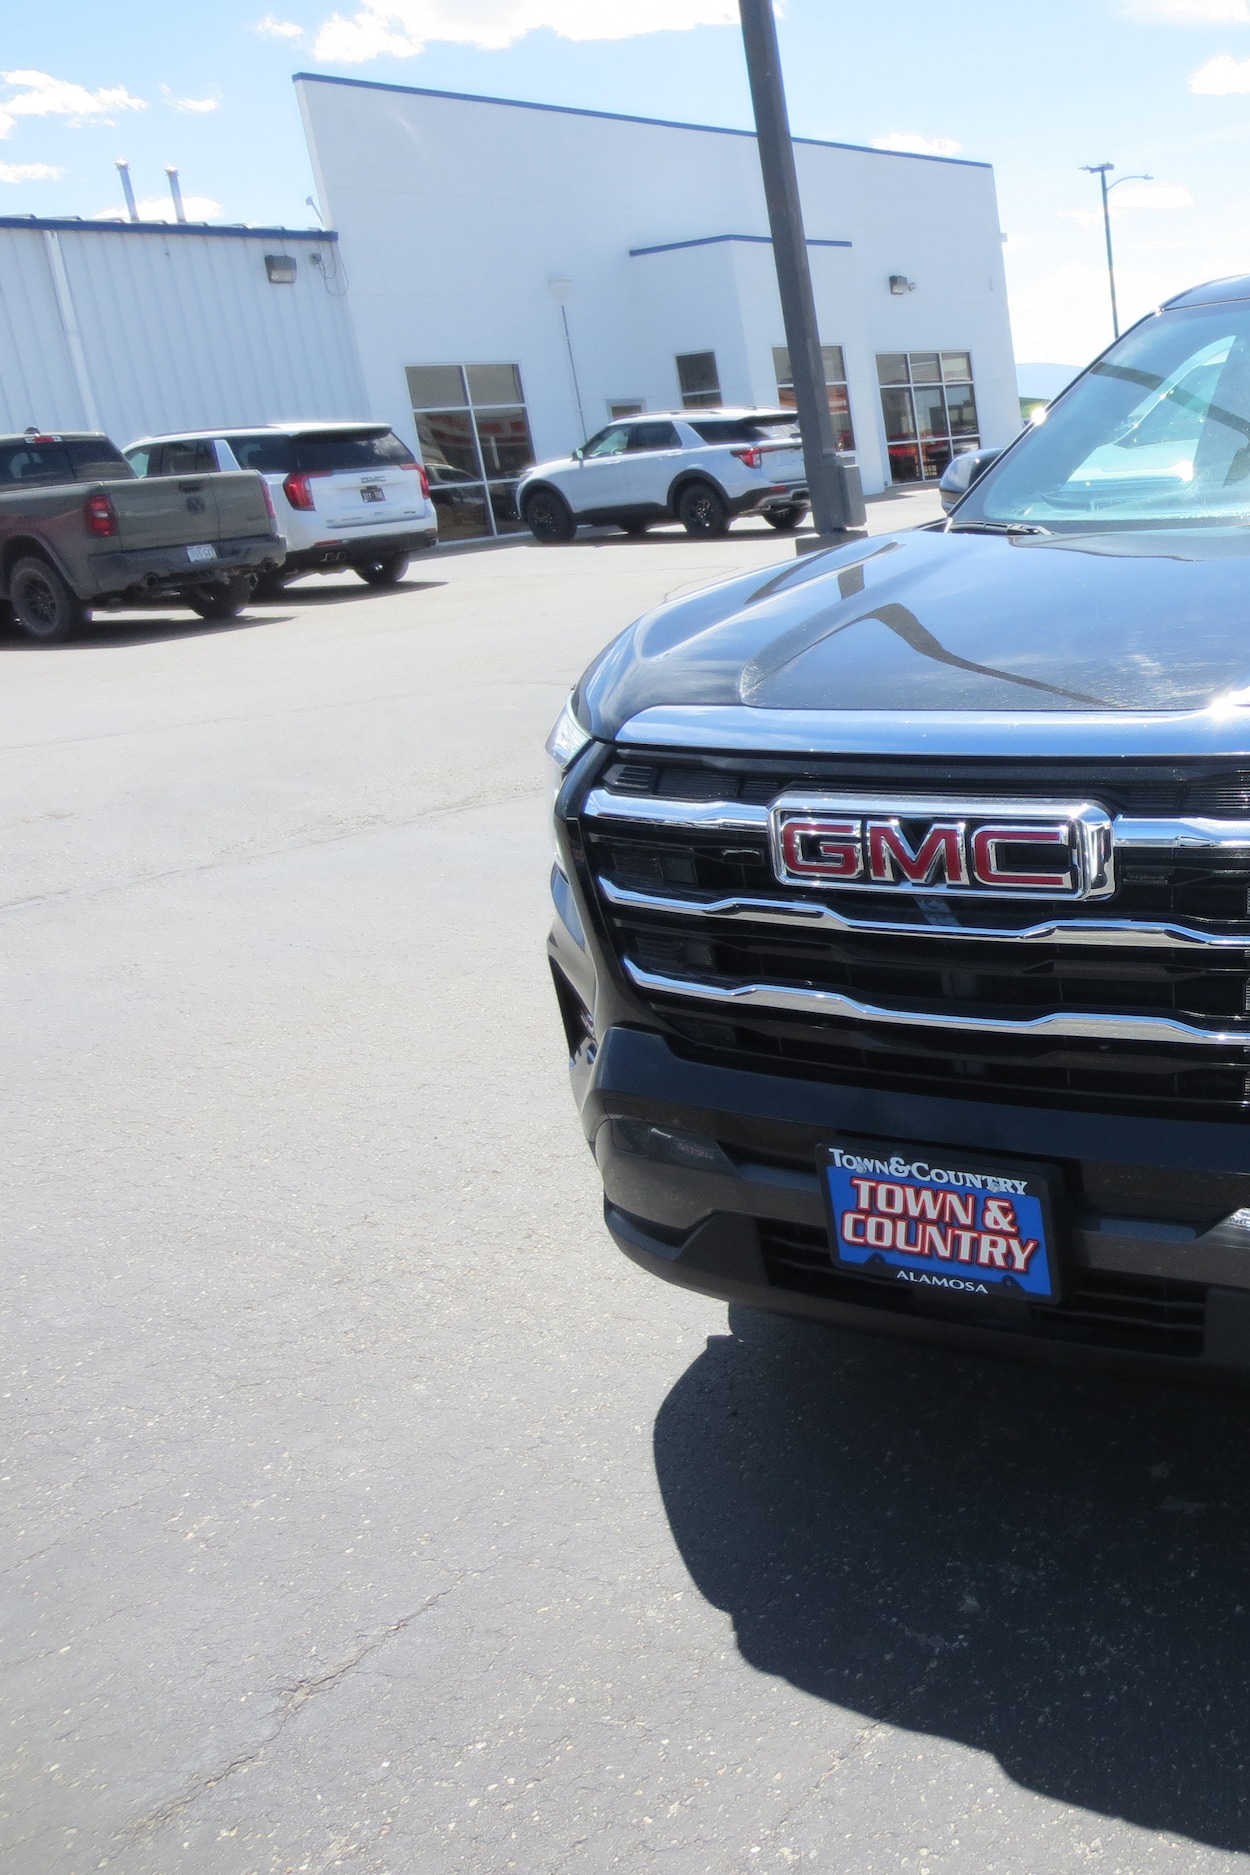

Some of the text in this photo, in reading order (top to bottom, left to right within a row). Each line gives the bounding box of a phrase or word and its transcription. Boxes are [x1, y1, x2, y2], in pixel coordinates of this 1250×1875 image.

[361, 476, 386, 484] GMC
[780, 817, 1072, 890] GMC
[851, 1177, 1019, 1235] TOWN &
[841, 1210, 1038, 1272] COUNTRY
[897, 1270, 988, 1294] ALAMOSA
